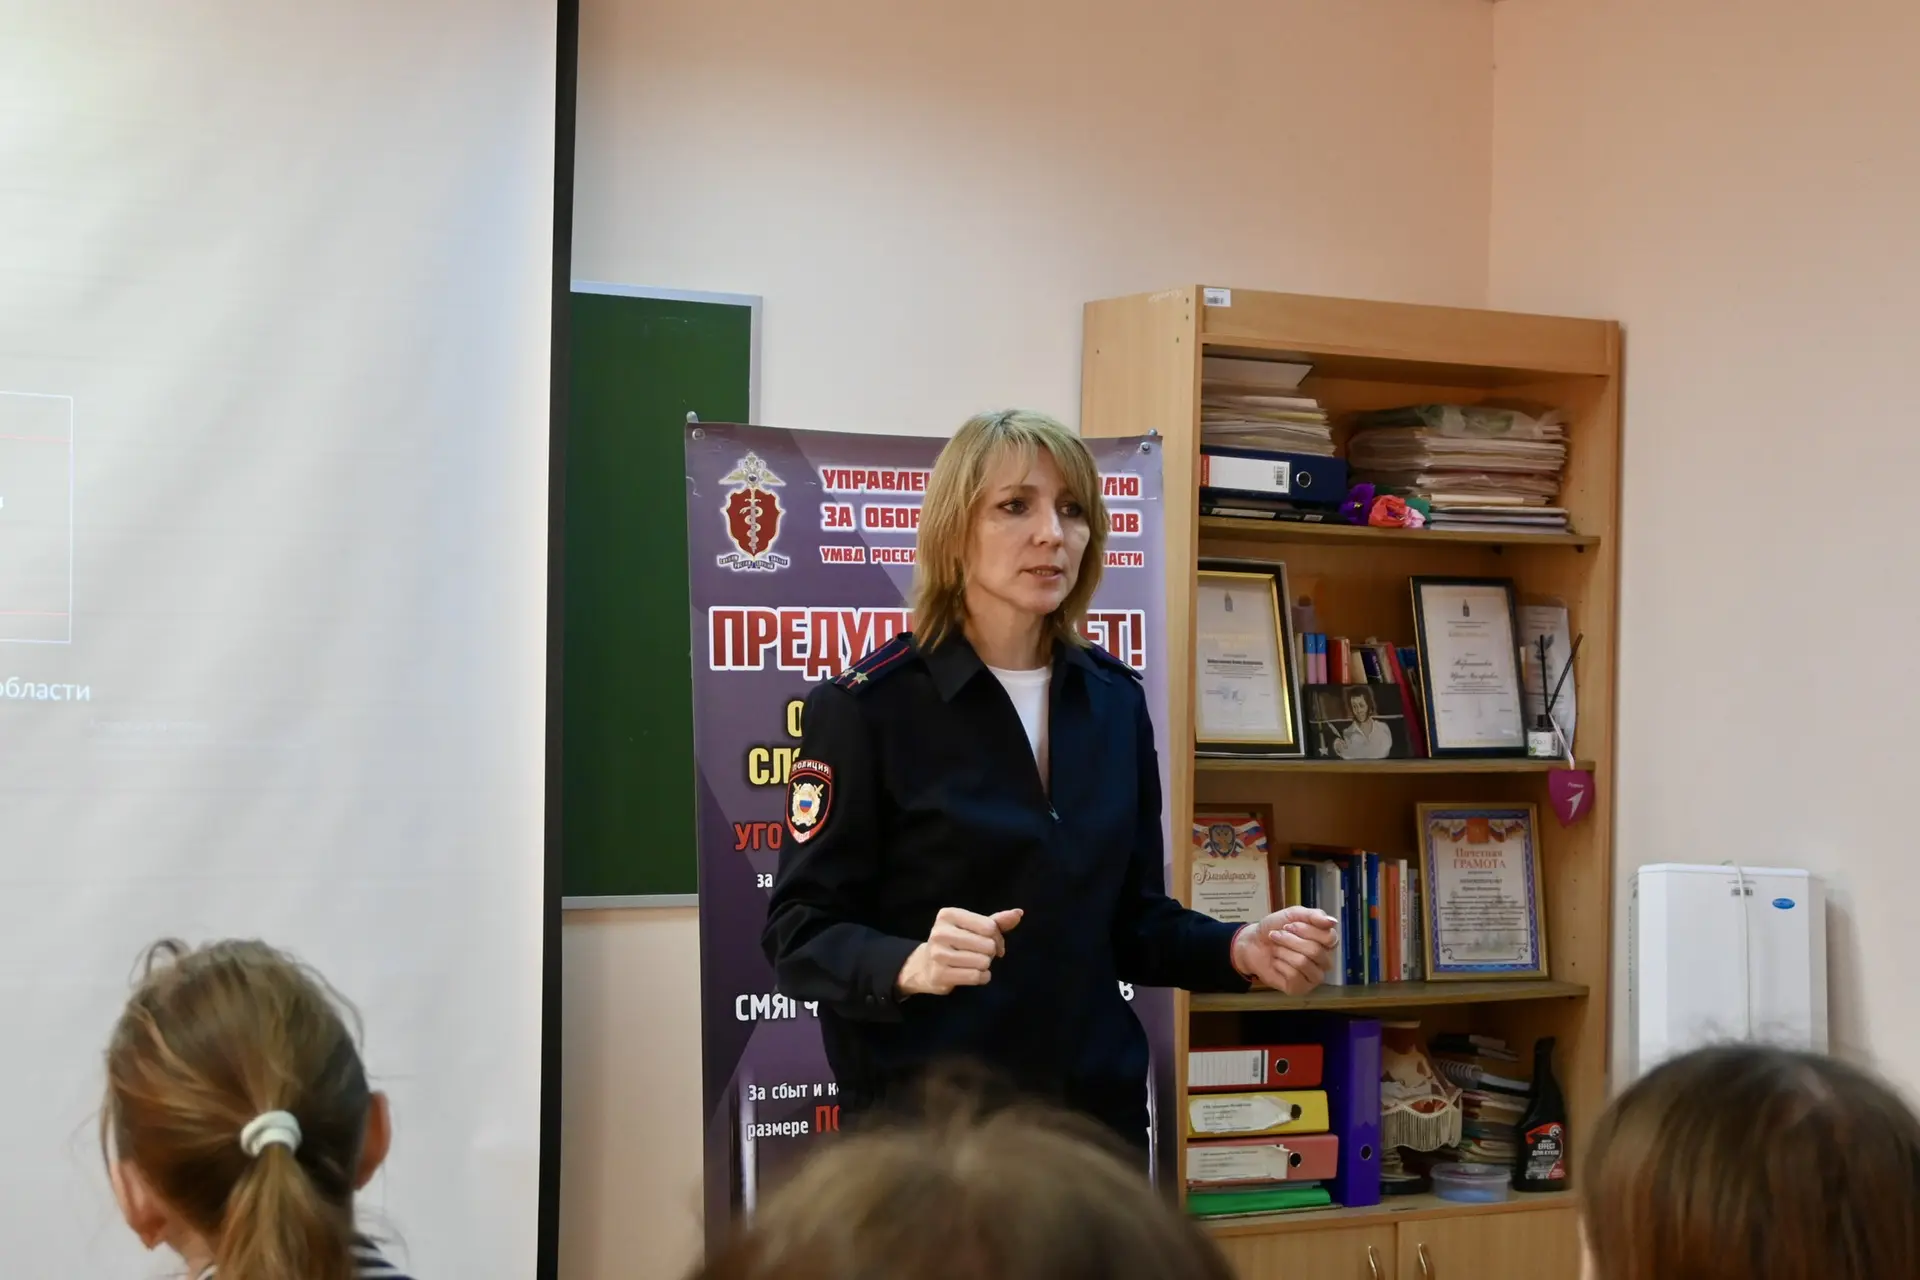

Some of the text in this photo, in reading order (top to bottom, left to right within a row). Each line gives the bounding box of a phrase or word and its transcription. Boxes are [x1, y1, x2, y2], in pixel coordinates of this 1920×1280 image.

[1098, 477, 1139, 496] ЛЮ
[824, 506, 852, 527] ЗА
[1108, 513, 1139, 533] ОВ
[821, 547, 864, 562] УМВД
[712, 610, 913, 677] ПРЕДУП
[748, 747, 800, 785] СЛ
[792, 761, 829, 775] ПОЛИЦИЯ
[734, 823, 782, 851] УГО
[757, 874, 773, 888] за
[748, 1082, 839, 1100] За сбыт и к
[747, 1120, 809, 1140] размере
